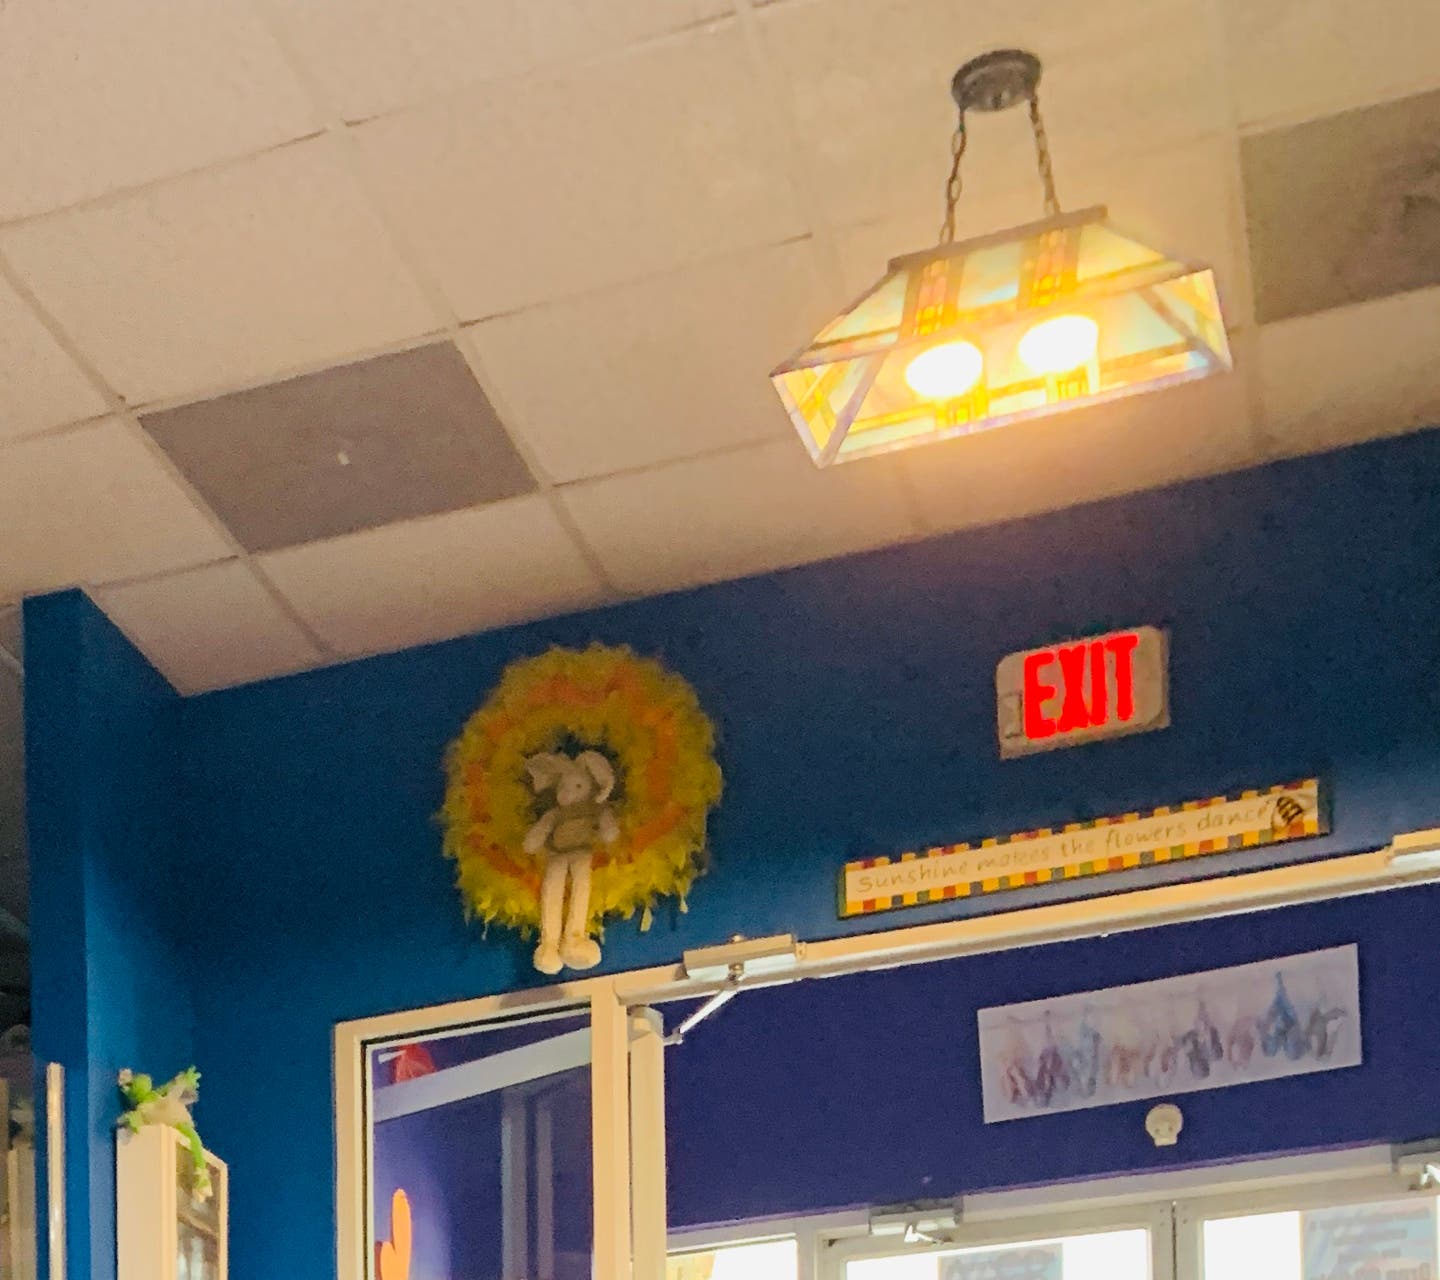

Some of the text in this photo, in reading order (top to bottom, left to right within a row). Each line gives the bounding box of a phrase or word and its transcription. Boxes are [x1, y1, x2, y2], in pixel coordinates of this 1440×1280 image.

[1024, 634, 1137, 739] EXIT
[977, 847, 1049, 872] makes
[1060, 836, 1095, 858] the
[1105, 819, 1188, 851] flowers
